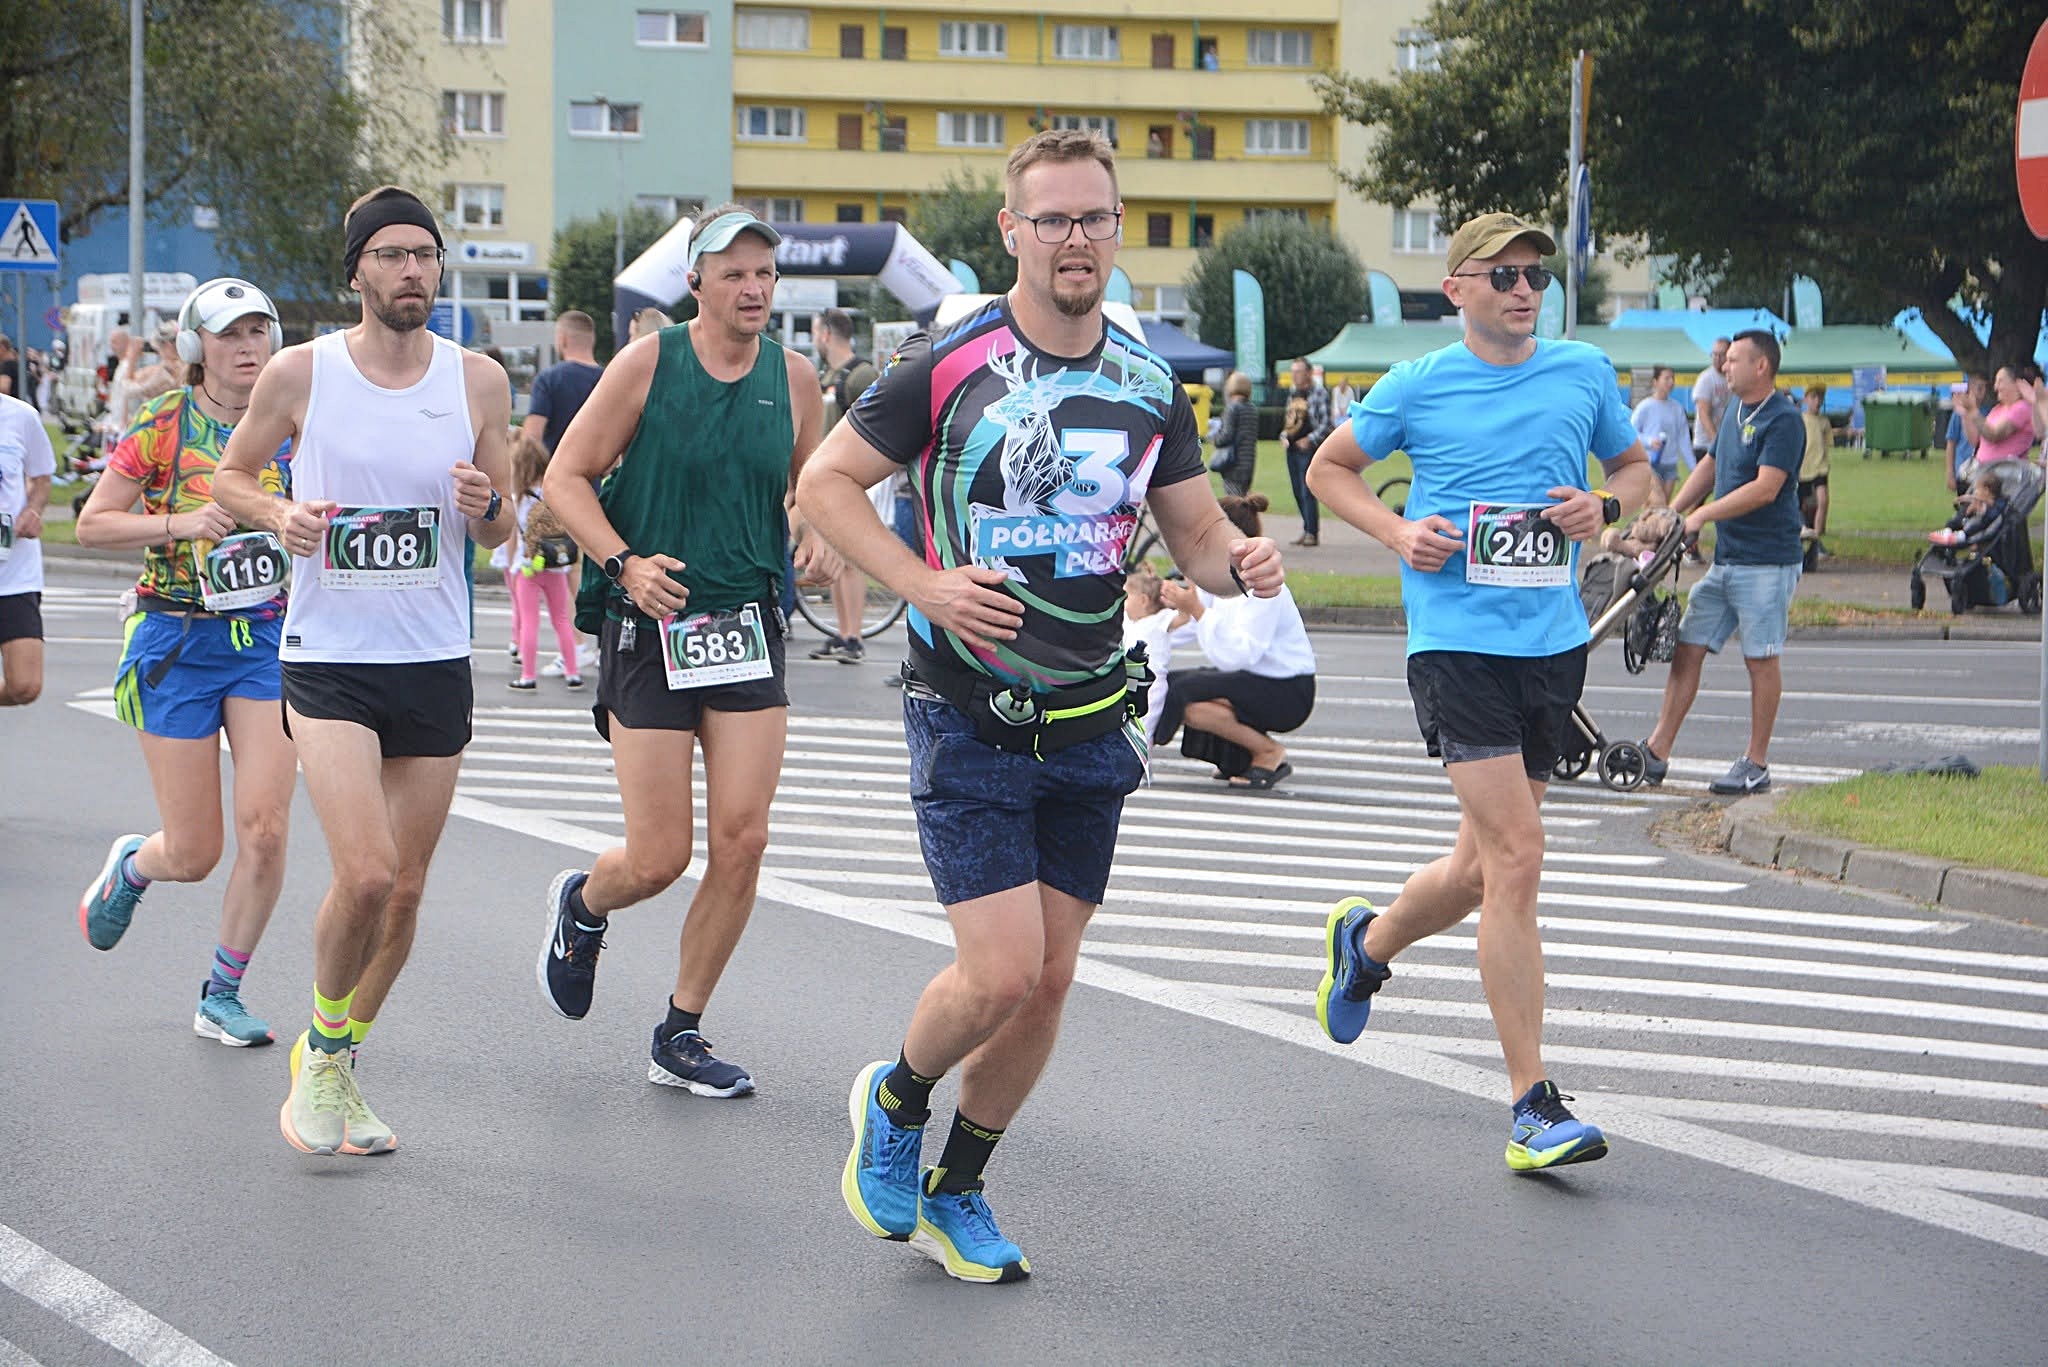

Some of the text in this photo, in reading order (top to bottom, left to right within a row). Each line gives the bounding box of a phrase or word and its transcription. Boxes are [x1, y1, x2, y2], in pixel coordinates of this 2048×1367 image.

[775, 234, 848, 265] tart
[1050, 430, 1127, 515] 3
[350, 533, 417, 567] 108
[1491, 531, 1554, 563] 249
[222, 555, 274, 588] 119
[687, 631, 745, 665] 583
